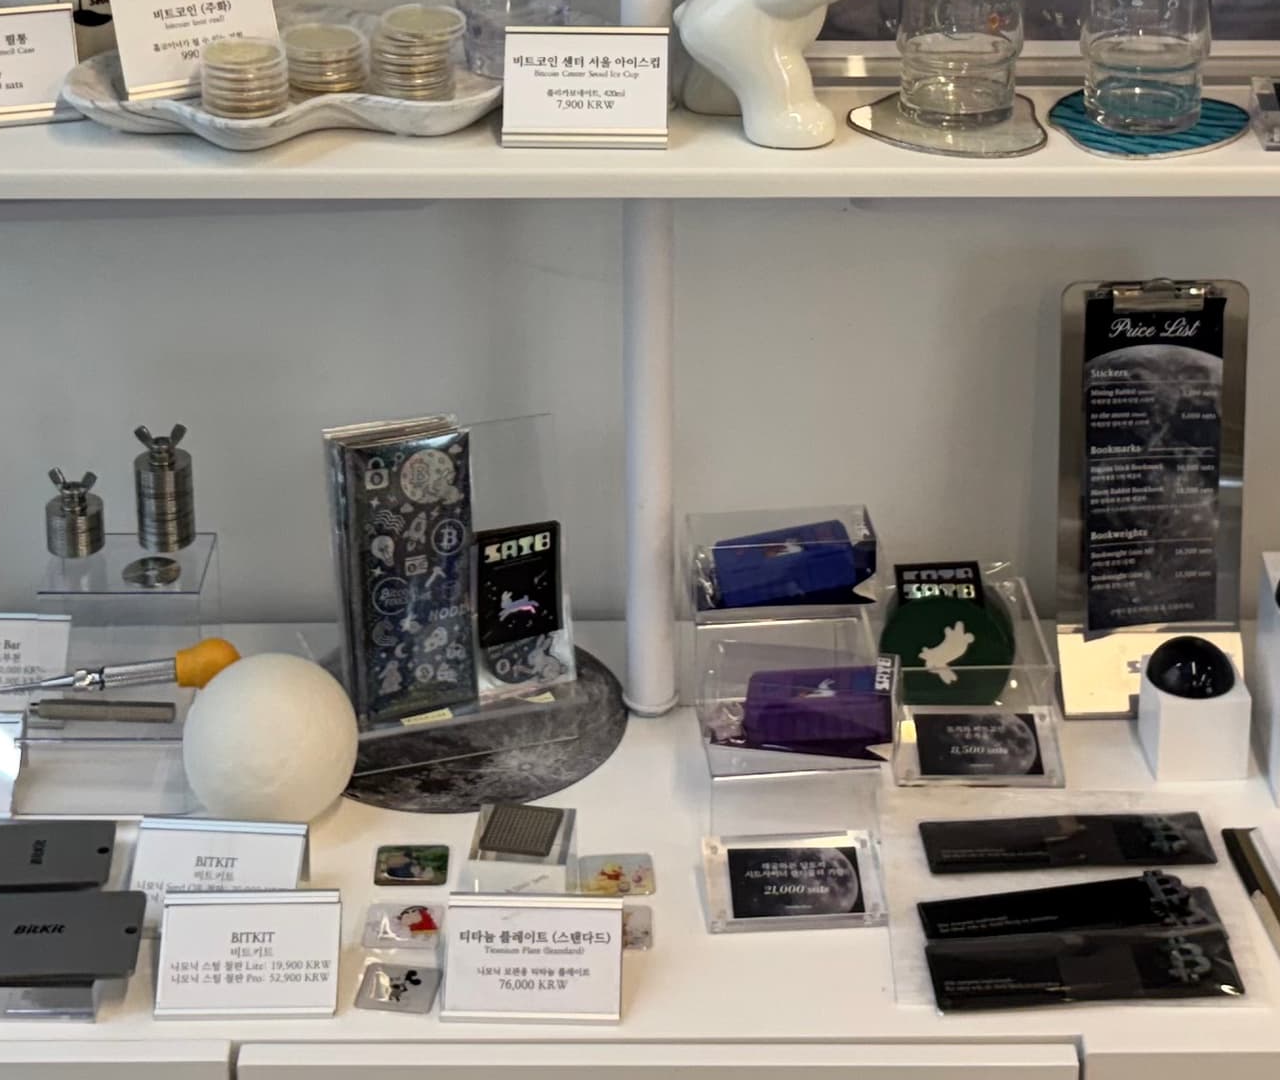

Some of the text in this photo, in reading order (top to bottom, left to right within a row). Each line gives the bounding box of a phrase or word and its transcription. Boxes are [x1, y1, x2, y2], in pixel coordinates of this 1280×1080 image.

[153, 0, 232, 21] 비트코인 (주화)
[5, 33, 28, 46] 필통
[181, 50, 200, 60] 990
[513, 56, 660, 69] 비트코인 센터 서울 아이스컵
[5, 81, 24, 90] sats
[556, 100, 615, 110] 7,900 KRW
[1109, 317, 1200, 338] Price List
[1090, 369, 1129, 379] Stickers
[1090, 444, 1141, 455] Bookmarks
[1090, 528, 1149, 540] Bookweights
[3, 639, 21, 650] Bar
[195, 855, 238, 869] BITKIT
[194, 871, 235, 881] 비트키트
[764, 885, 805, 895] 21,000
[13, 923, 66, 936] BitKit
[231, 932, 275, 944] BITKIT
[459, 930, 612, 945] 티타늄 플레이트 (스탠다드)
[230, 946, 274, 958] 비트키트
[485, 946, 520, 955] Titanium
[522, 946, 541, 955] Plate
[171, 960, 331, 971] 니모닉 스틸 철판 Lite: 19,900 KRW
[171, 973, 330, 985] 니모닉 스틸 철판 Pro: 52,900 KRW
[499, 979, 569, 991] 76,000 KRW
